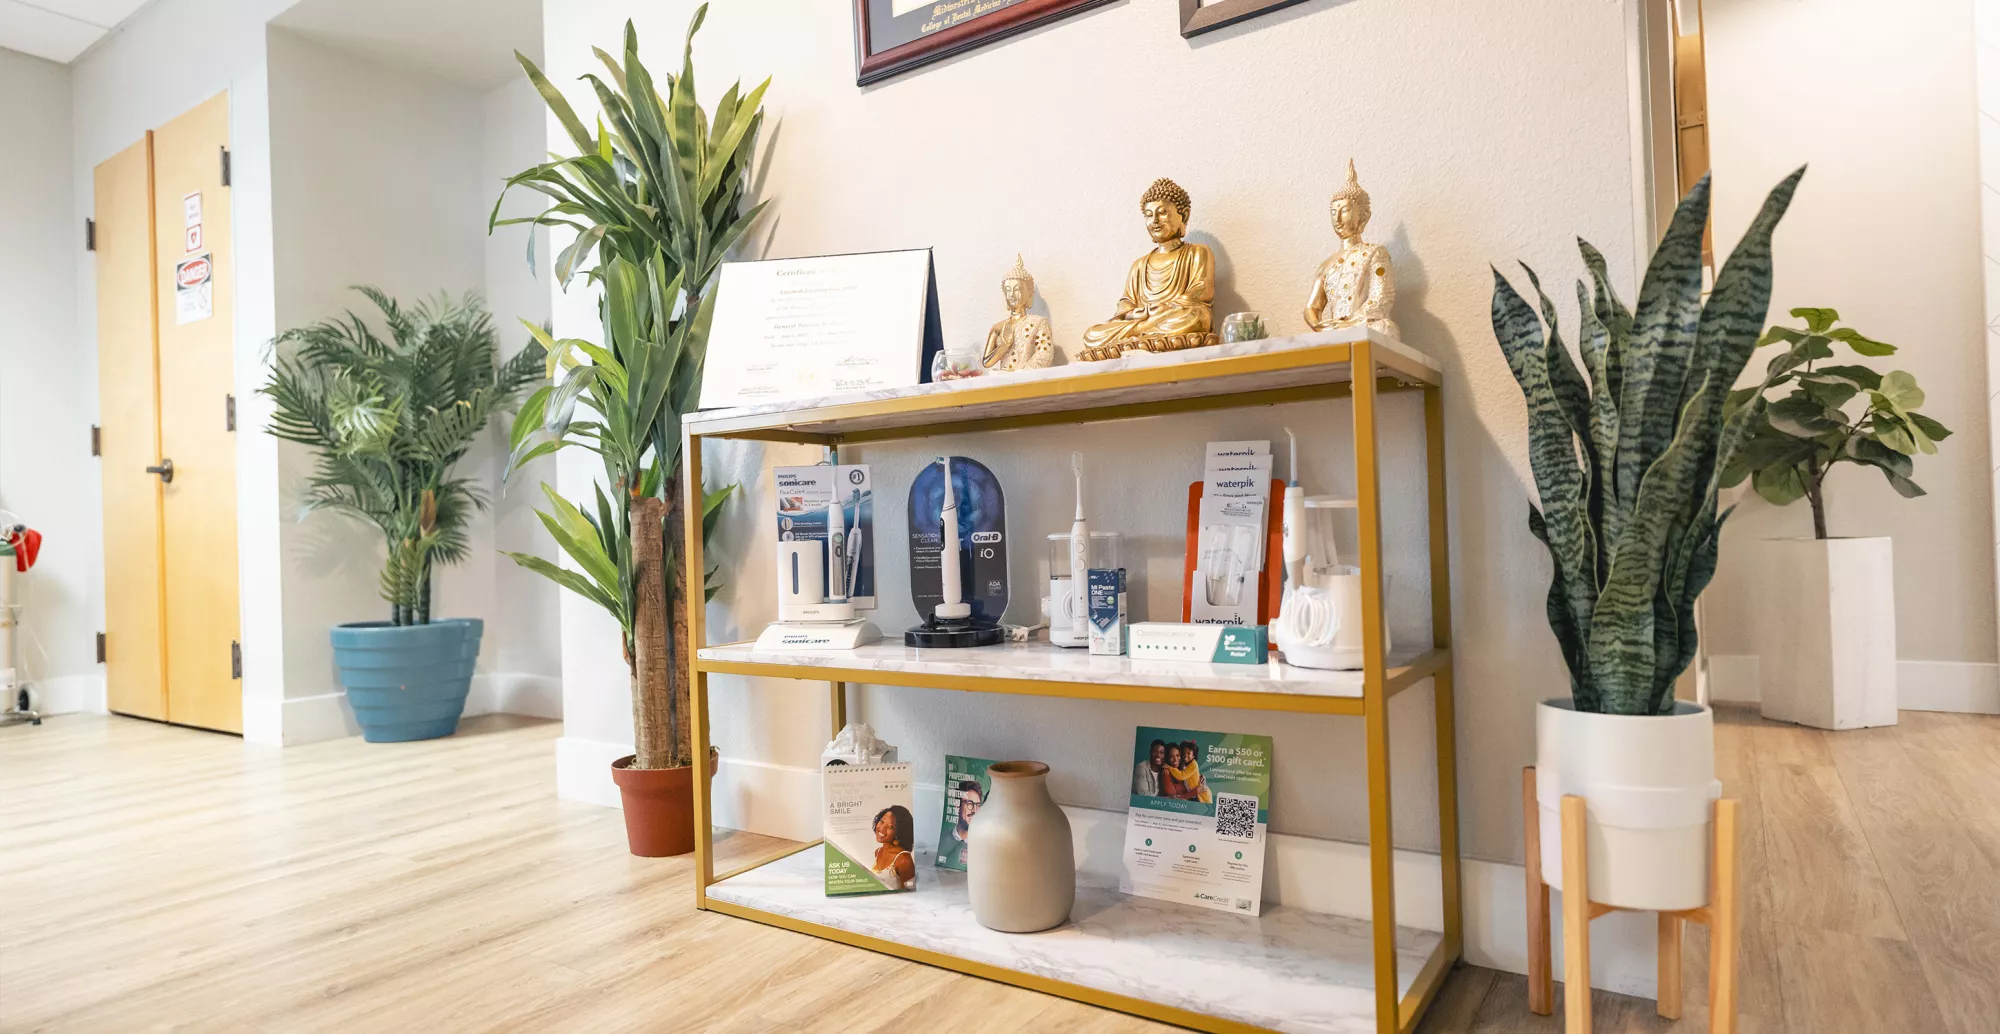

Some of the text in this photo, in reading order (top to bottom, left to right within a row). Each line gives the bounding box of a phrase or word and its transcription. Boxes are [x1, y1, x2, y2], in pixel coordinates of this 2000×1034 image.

[932, 0, 976, 20] Midwester
[778, 478, 817, 487] sonicare
[1216, 475, 1255, 489] waterpik
[973, 533, 1000, 541] Oral-B
[980, 547, 995, 559] iO
[782, 637, 830, 645] sonicare
[1208, 744, 1228, 755] Earn
[1235, 746, 1252, 757] $50
[1252, 750, 1264, 758] or
[1206, 754, 1226, 764] $100
[1226, 756, 1242, 767] gift
[836, 800, 863, 808] BRIGHT
[1150, 800, 1188, 810] APPLY TODAY
[1200, 893, 1230, 903] CareCredit
